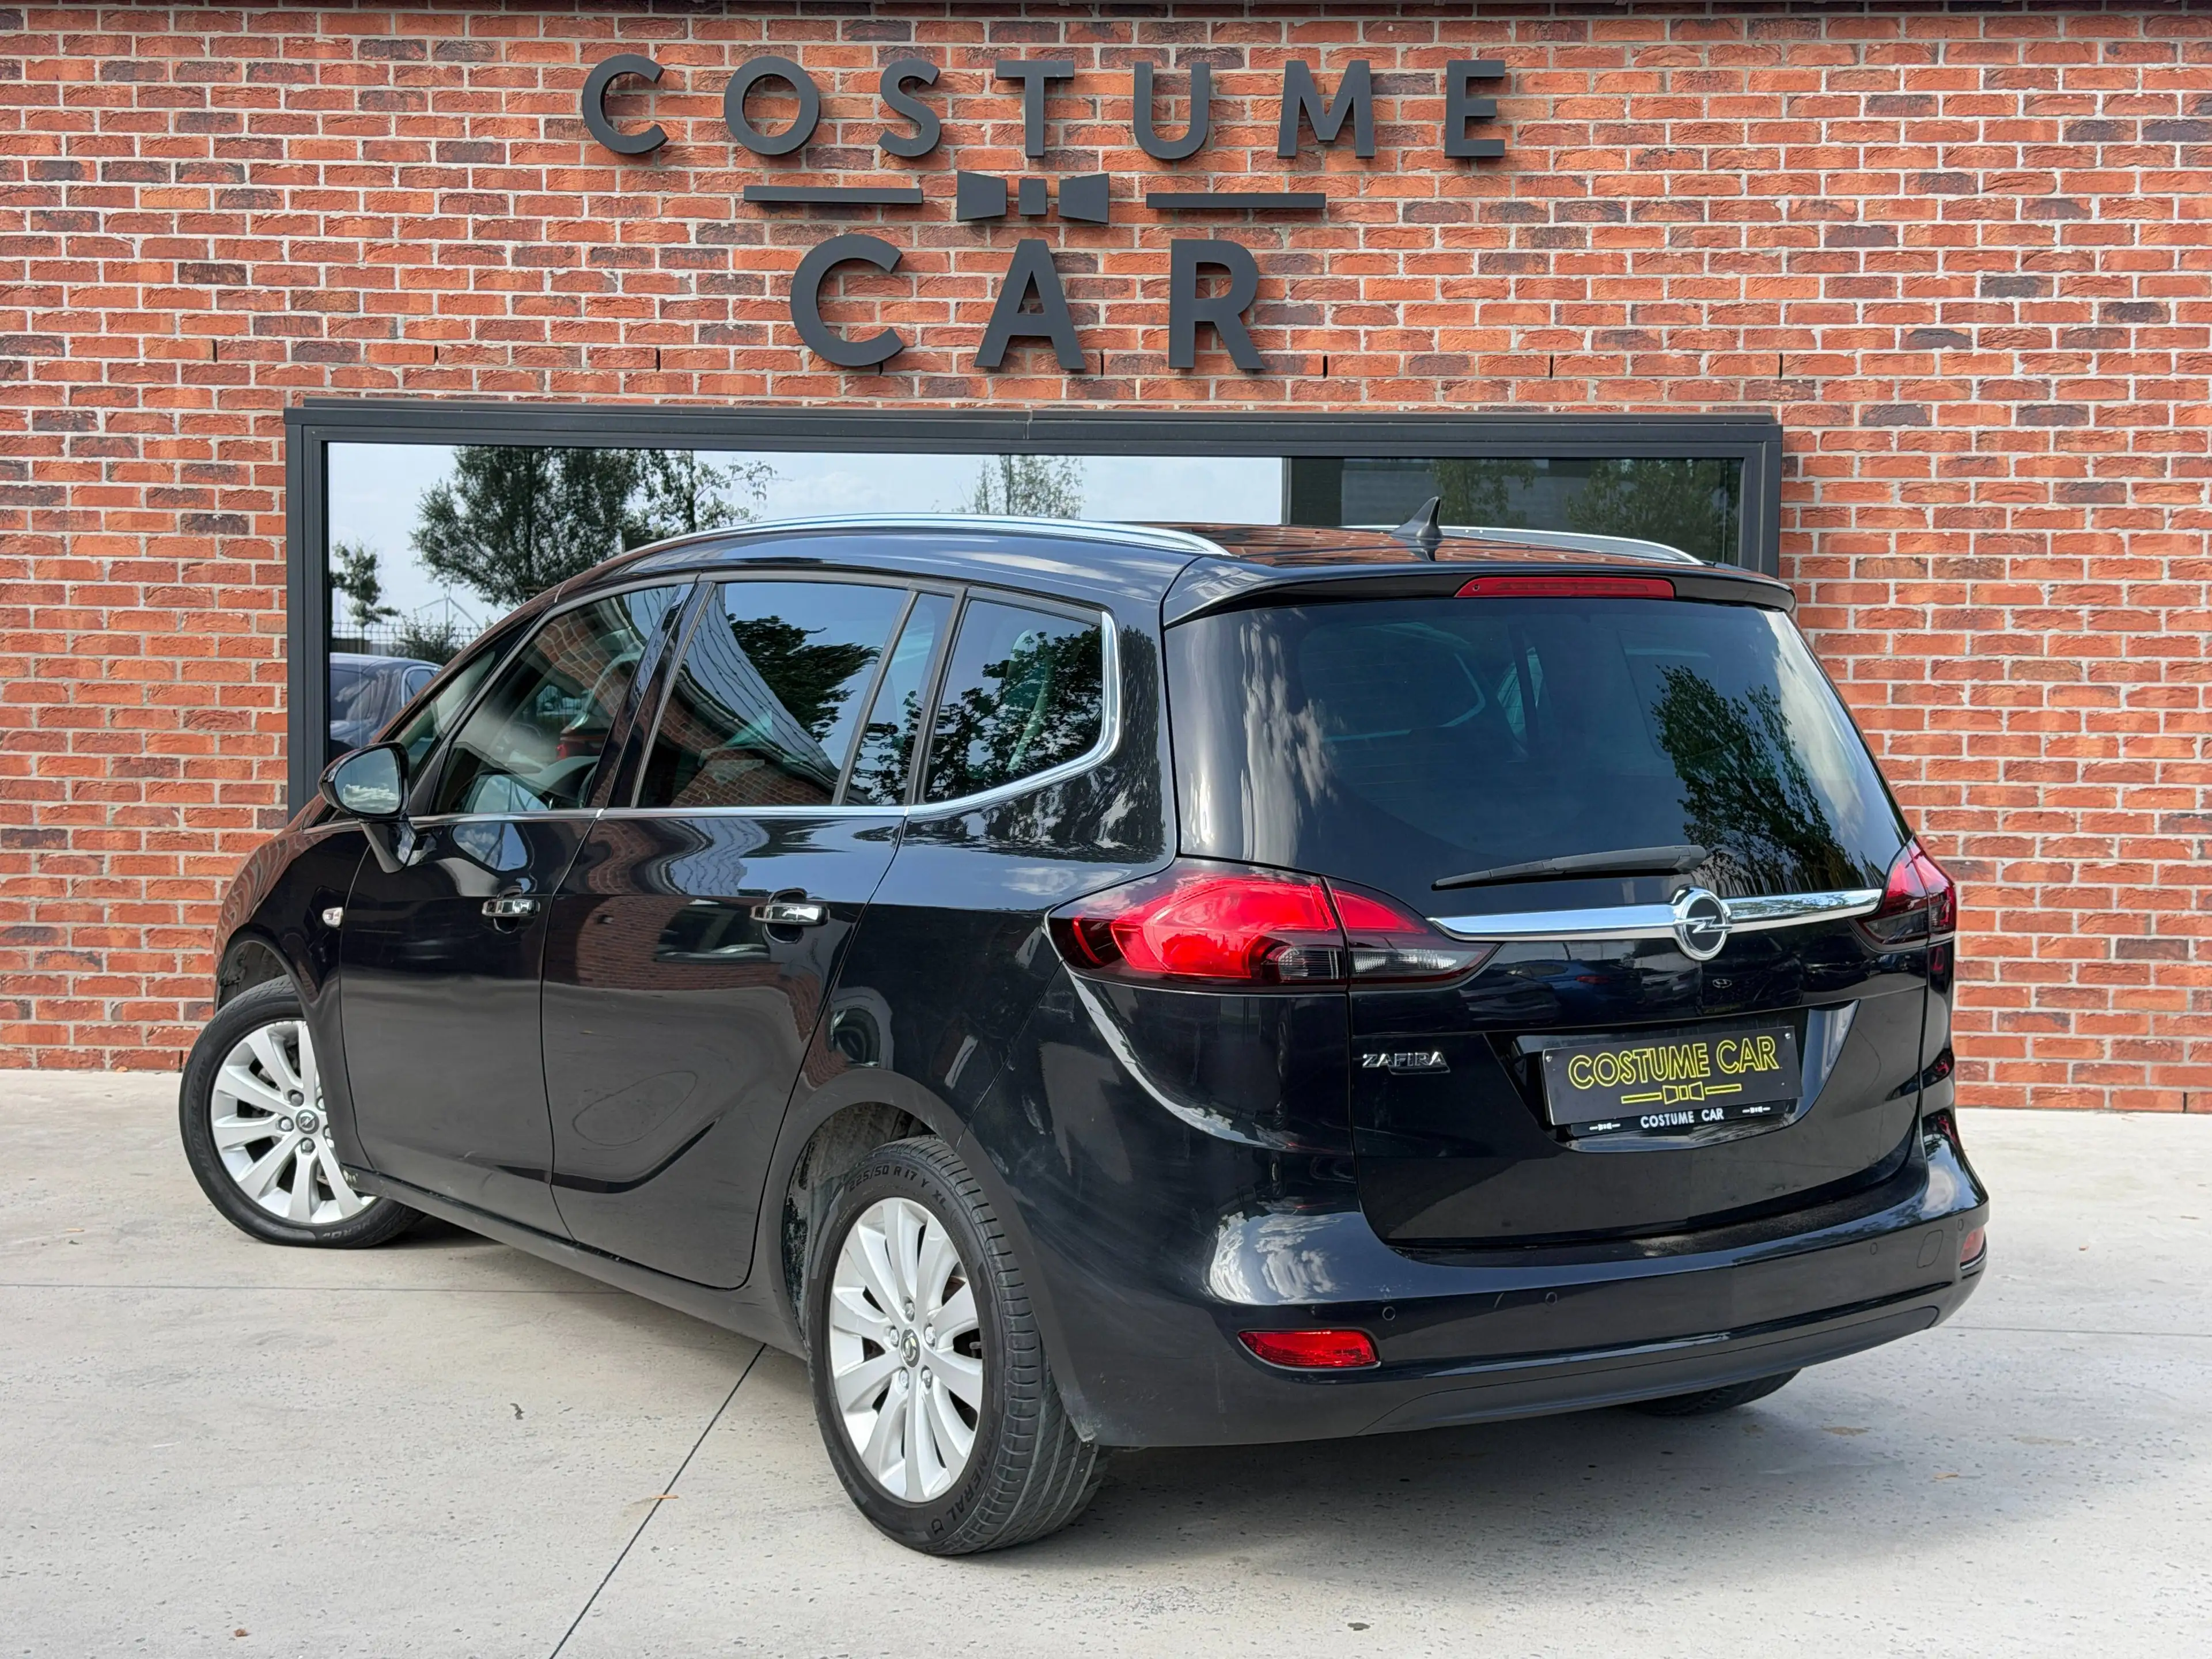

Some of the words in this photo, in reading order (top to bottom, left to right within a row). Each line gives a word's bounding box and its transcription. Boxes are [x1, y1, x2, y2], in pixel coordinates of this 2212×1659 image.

[581, 53, 1508, 161] COSTUME
[790, 233, 1266, 372] CAR
[1362, 1051, 1447, 1069] ZAFIRA
[1568, 1043, 1711, 1089] COSTUME
[1716, 1036, 1779, 1074] CAR
[1640, 1110, 1695, 1128] COSTUME
[1700, 1107, 1725, 1122] CAR
[849, 1165, 890, 1192] 225/50
[893, 1165, 903, 1177] R
[904, 1169, 918, 1181] 17
[931, 1190, 948, 1210] XL
